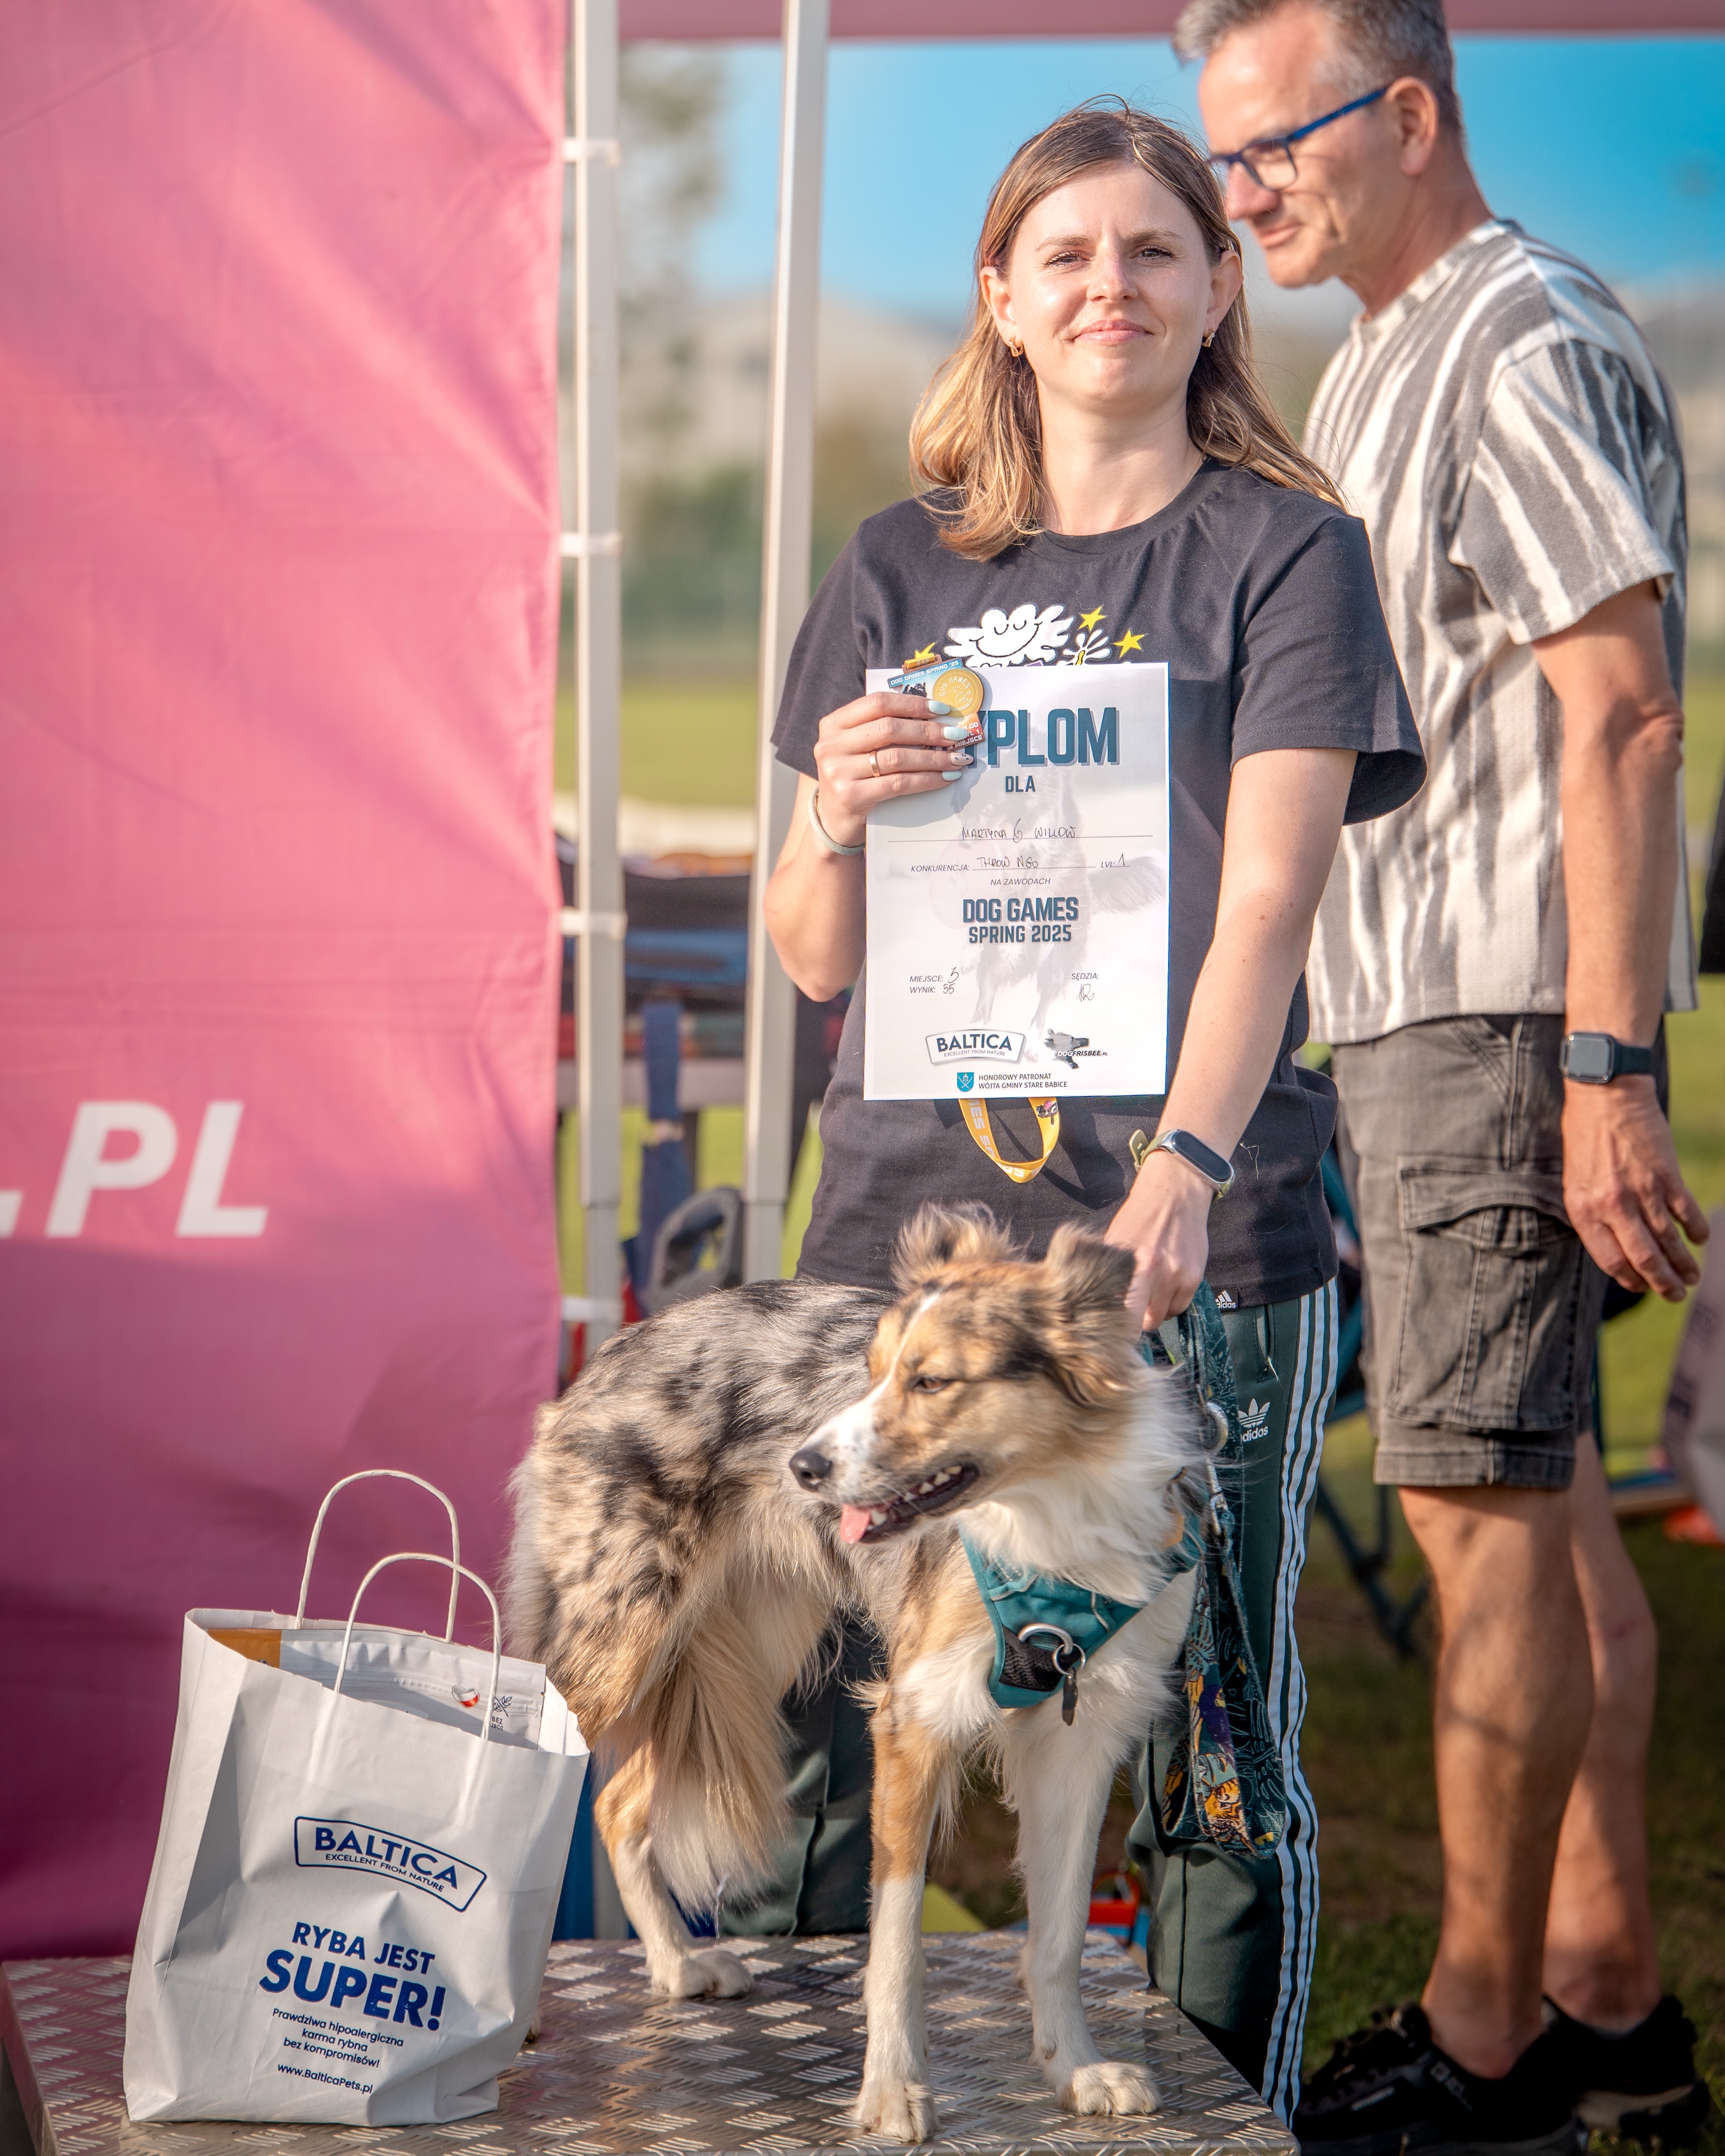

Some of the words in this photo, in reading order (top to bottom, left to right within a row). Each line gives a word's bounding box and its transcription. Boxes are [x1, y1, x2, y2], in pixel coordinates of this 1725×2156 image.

[905, 671, 926, 681] GAMES
[926, 664, 948, 674] SPRING
[938, 682, 948, 697] DOG
[949, 676, 971, 688] GAMES
[955, 735, 983, 748] MIEJSCE
[1006, 775, 1036, 793] DLA
[962, 827, 1007, 839] MARTYNA
[1035, 826, 1076, 838] WILLOW
[911, 864, 969, 872] KONKURENCJA:
[977, 856, 1010, 867] THROW
[963, 898, 1002, 924] DOG
[1007, 897, 1079, 922] GAMES
[969, 925, 1025, 944] SPRING
[1031, 924, 1072, 943] 2025
[1071, 972, 1099, 980] SĘDZIA:
[936, 1033, 1012, 1052] BALTICA
[979, 1081, 1001, 1089] WÓJTA
[1240, 1426, 1269, 1443] didas
[492, 1716, 503, 1724] BEZ
[314, 1826, 457, 1890] BALTICA
[325, 1854, 378, 1867] EXCELLENT
[380, 1862, 407, 1876] FROM
[409, 1872, 444, 1892] NATURE
[292, 1921, 366, 1961] RYBA
[373, 1943, 436, 1975] JEST
[259, 1949, 446, 2032] SUPER!
[272, 2008, 326, 2029] Prawdziwa
[329, 2021, 404, 2047] hipoalergiczna
[302, 2028, 335, 2045] karma
[337, 2038, 368, 2052] rybna
[283, 2037, 302, 2048] bez
[304, 2041, 380, 2068] kompromisów!
[277, 2064, 373, 2094] www.BalticaPets.pl
